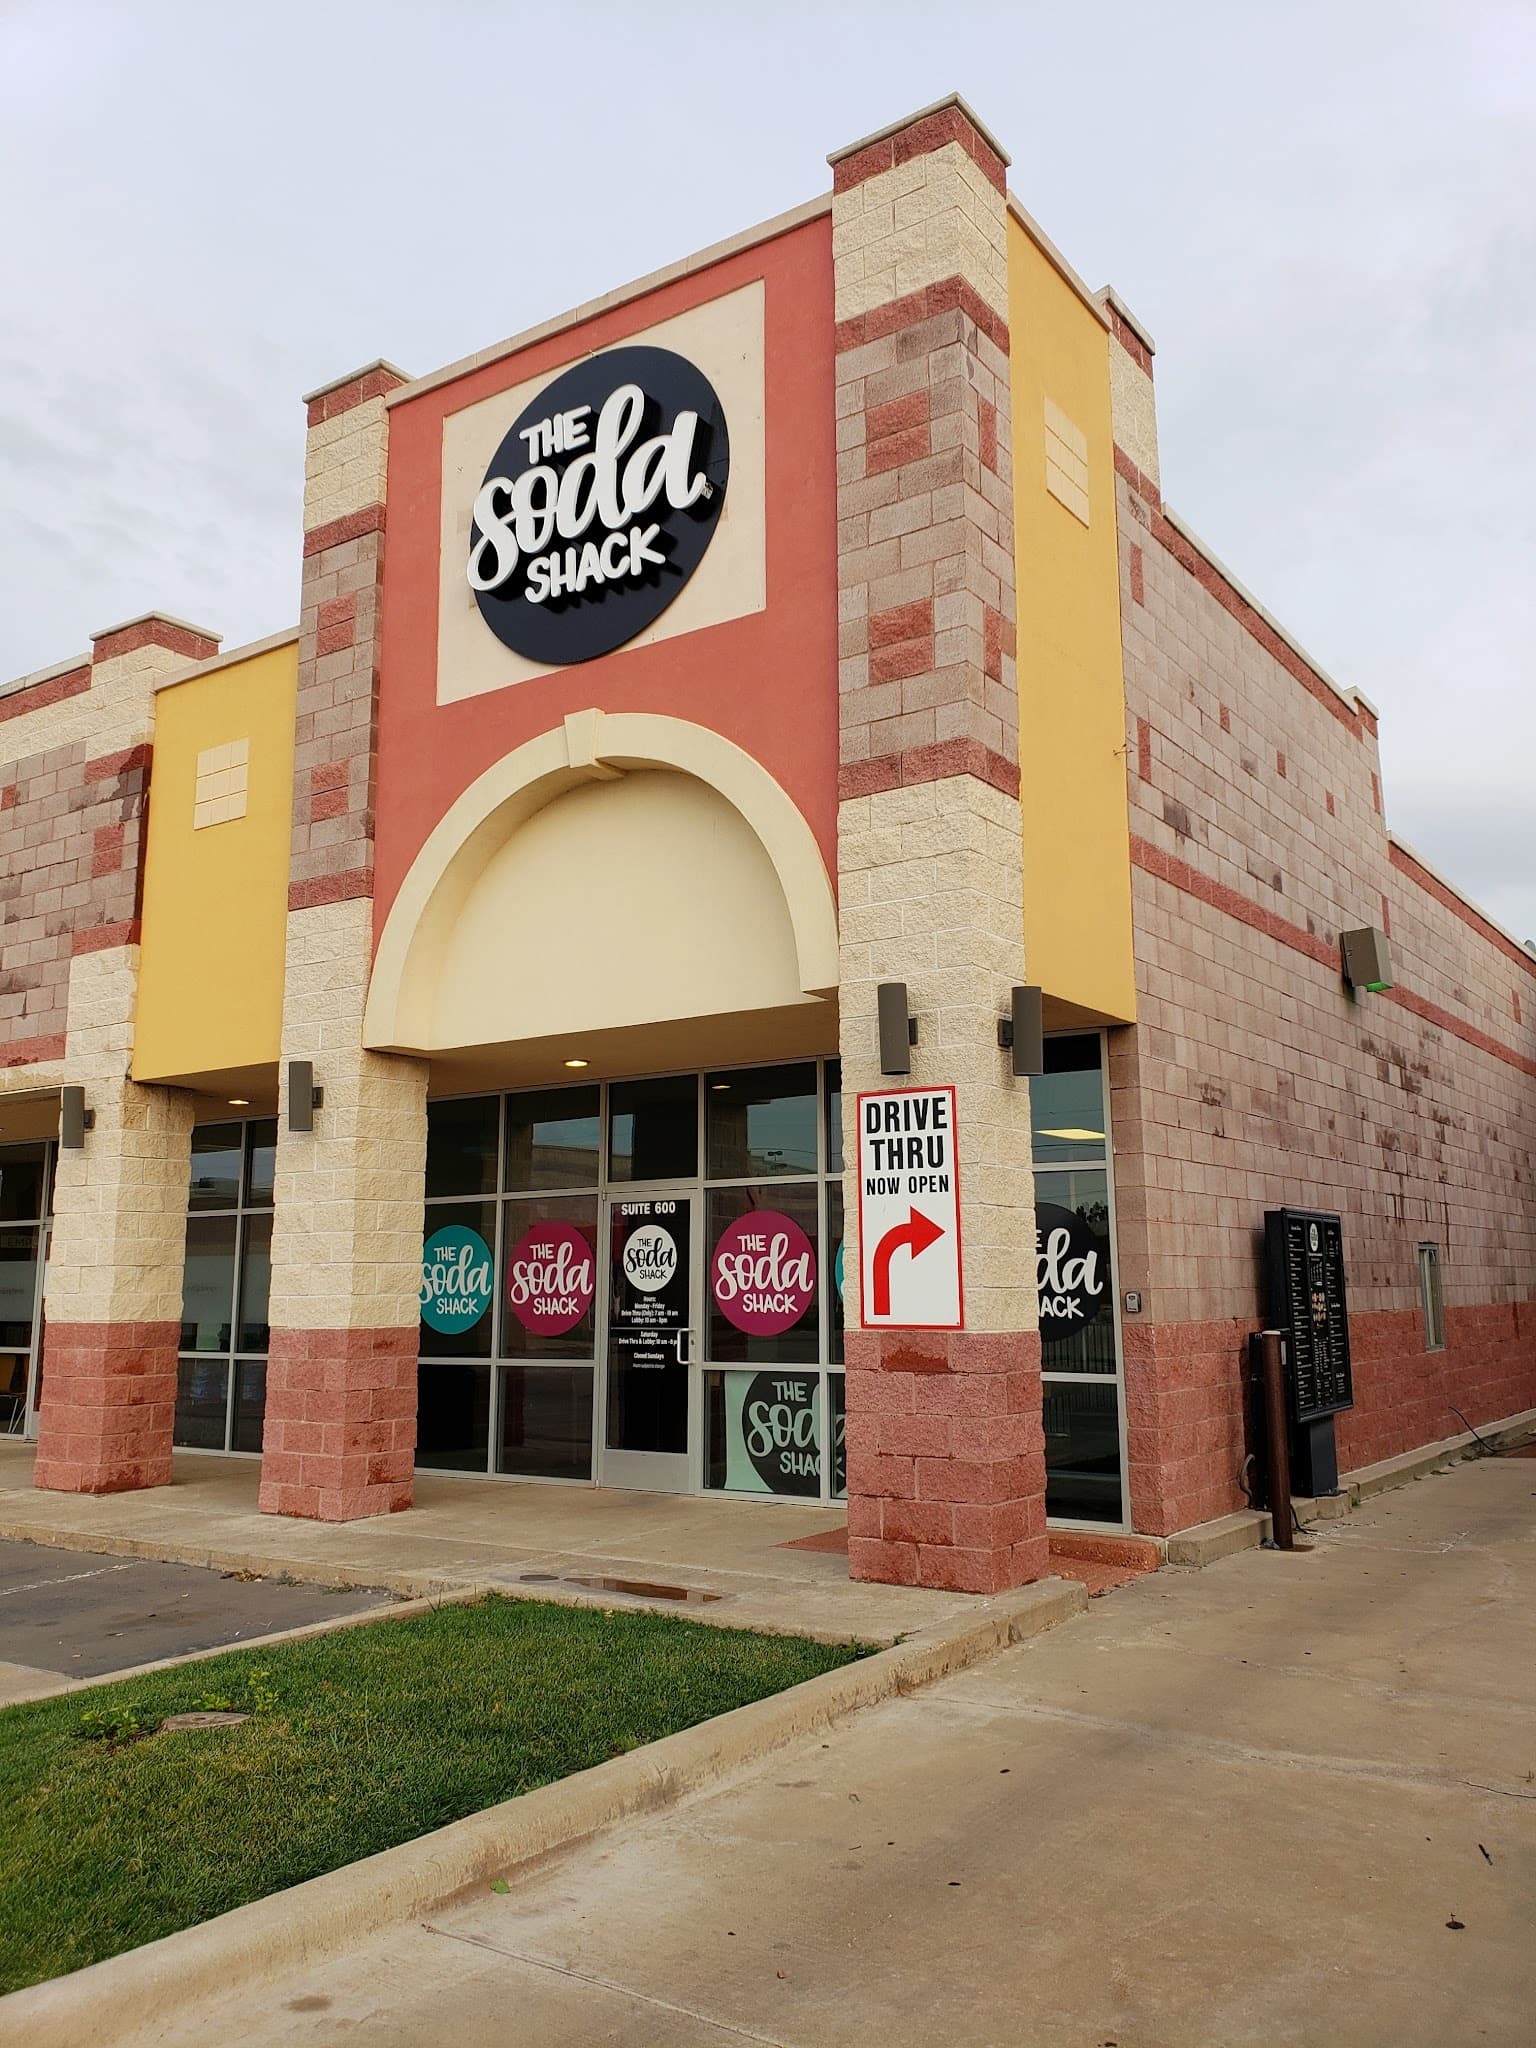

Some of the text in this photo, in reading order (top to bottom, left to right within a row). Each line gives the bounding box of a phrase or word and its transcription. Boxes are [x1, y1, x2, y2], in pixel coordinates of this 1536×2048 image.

[519, 405, 591, 464] THE
[466, 383, 707, 591] soda
[524, 523, 666, 604] SHACK
[866, 1096, 948, 1134] DRIVE
[869, 1135, 944, 1171] THRU
[866, 1174, 949, 1196] NOW OPEN
[621, 1201, 676, 1216] SUITE 600
[529, 1243, 555, 1260] THE
[637, 1238, 653, 1248] THE
[737, 1233, 767, 1252] THE
[434, 1246, 457, 1262] THE
[1037, 1227, 1104, 1296] da
[510, 1241, 593, 1304] soda
[640, 1269, 668, 1280] SHACK
[715, 1232, 814, 1300] soda
[436, 1297, 479, 1315] SHACK
[533, 1297, 580, 1315] SHACK
[742, 1293, 799, 1314] SHACK
[1040, 1295, 1085, 1319] ACK
[771, 1381, 807, 1402] THE
